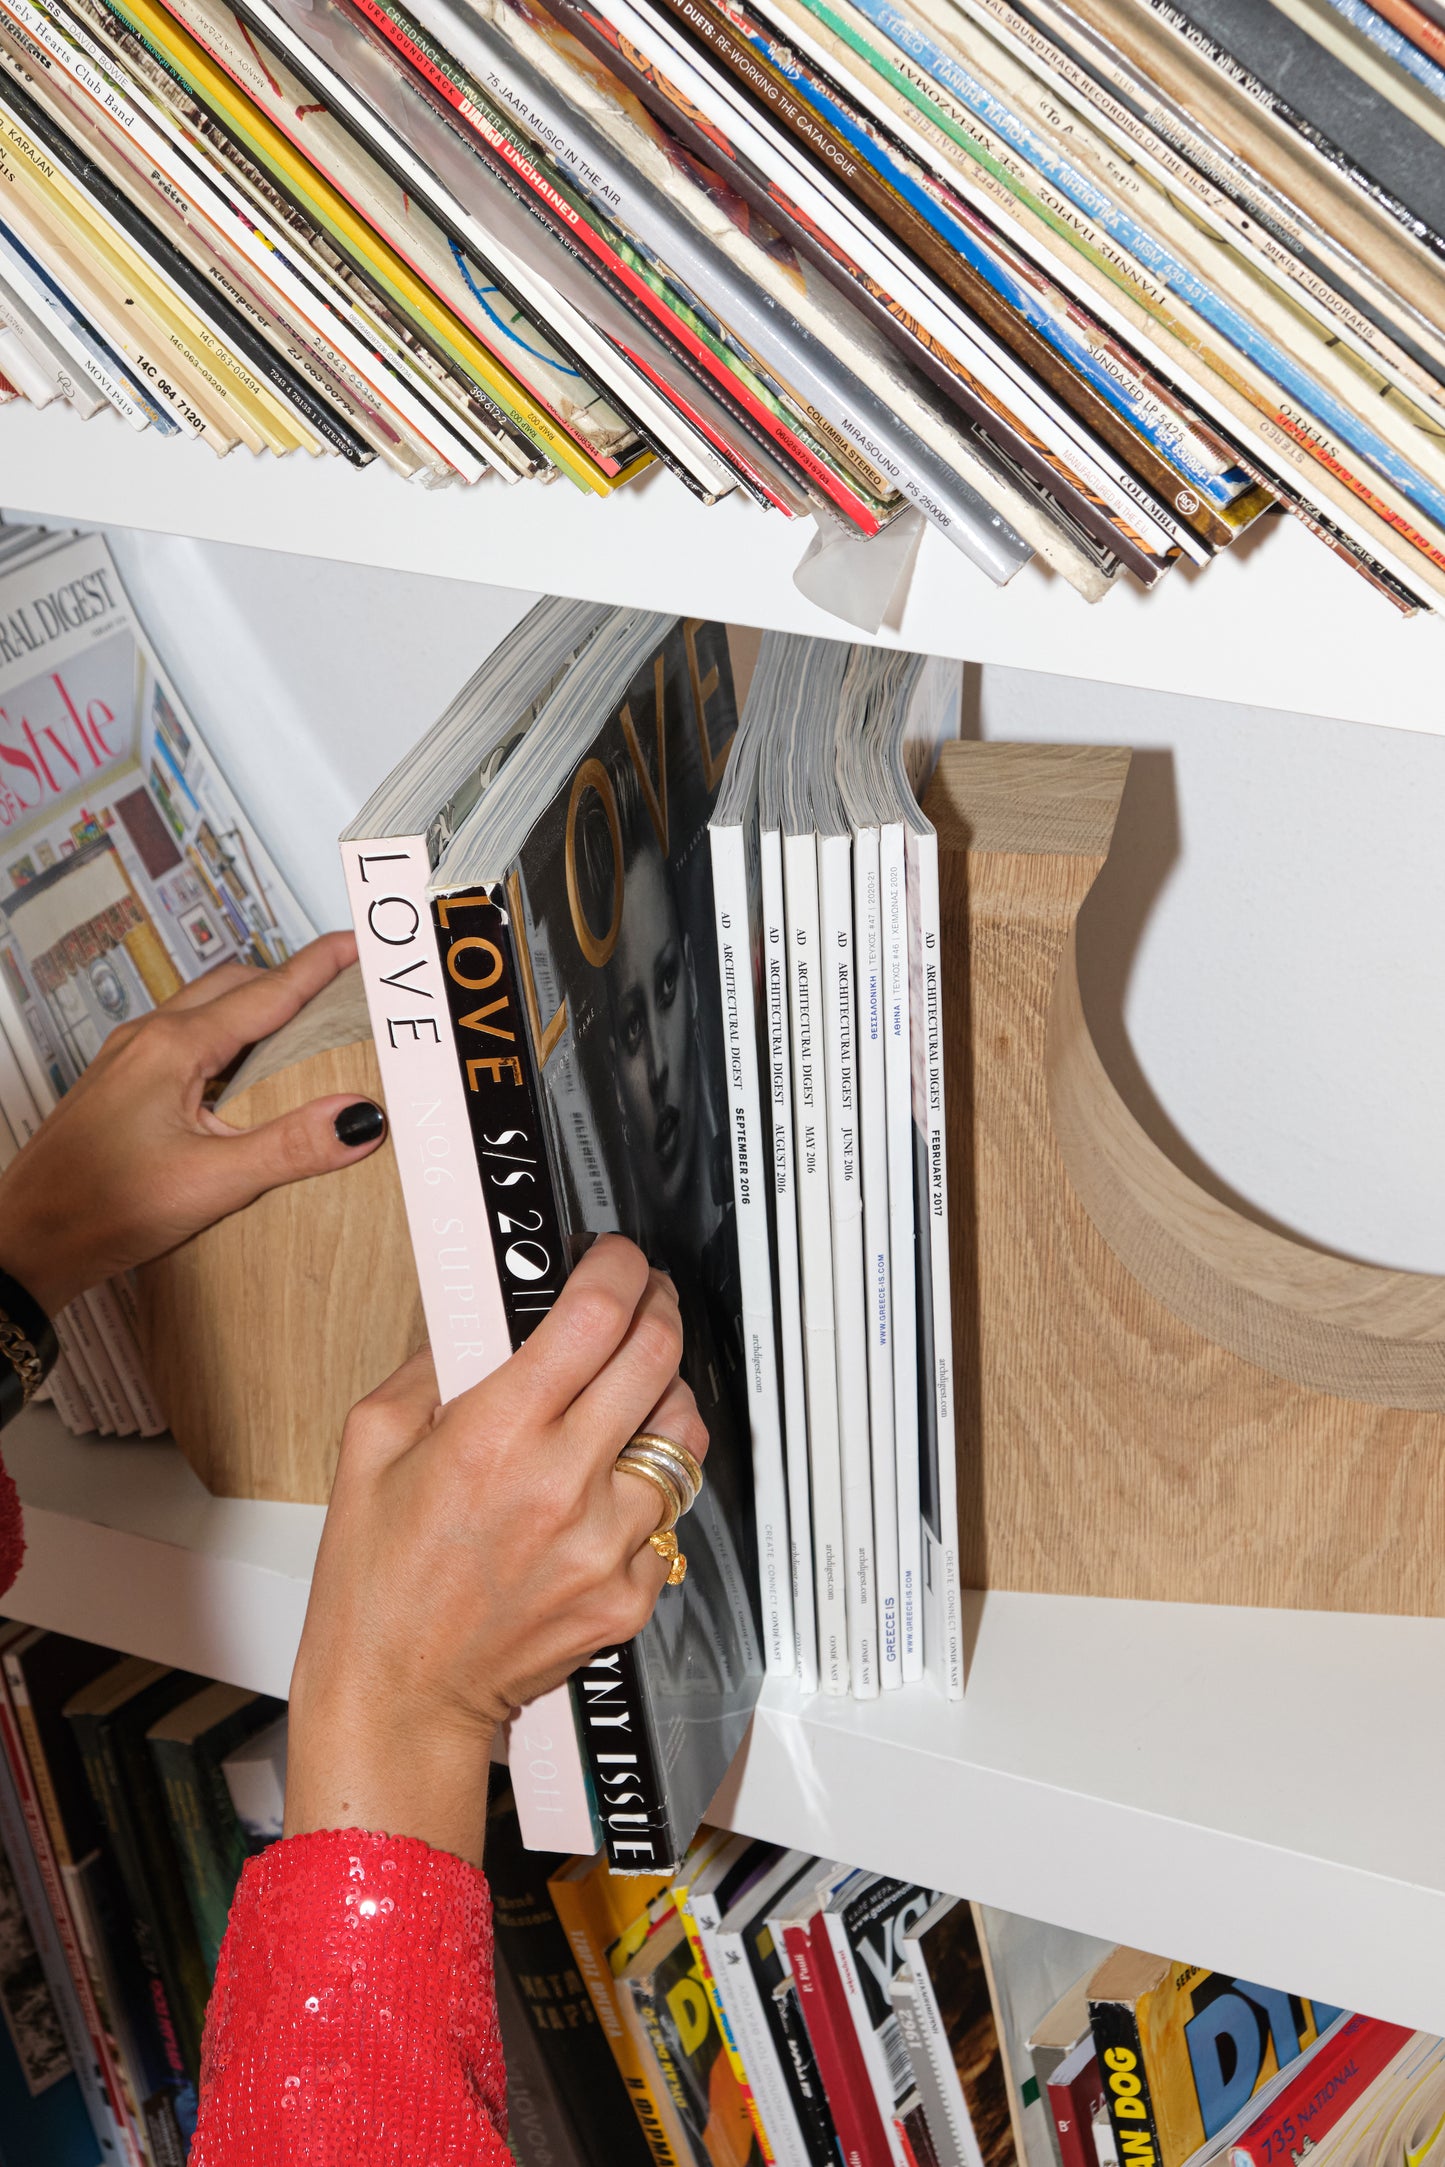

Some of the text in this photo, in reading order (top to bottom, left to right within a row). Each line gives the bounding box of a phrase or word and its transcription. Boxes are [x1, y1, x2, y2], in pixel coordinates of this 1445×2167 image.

[35, 22, 136, 128] Hearts Club Band
[98, 56, 130, 88] BOWIE
[386, 7, 540, 169] CREEDENCE CLEARWATER REVIVAL
[390, 27, 456, 97] SOUNDTRACK
[683, 5, 717, 40] DUETS:
[714, 34, 779, 101] RE-WORKING
[778, 95, 799, 119] THE
[796, 114, 858, 179] CATALOGUE
[1005, 15, 1080, 83] SOUNDTRACK
[1080, 77, 1145, 140] RECORDING
[1144, 136, 1160, 152] OF
[1161, 151, 1184, 172] THE
[8, 129, 54, 178] KARAJAN
[457, 97, 579, 225] DJANGO UNCHAINED
[486, 72, 622, 206] 75 JAAR MUSIC IN THE AIR
[1132, 236, 1206, 303] MSM 430-431
[1265, 241, 1297, 272] MIKIS
[209, 266, 272, 329] Klemperer
[85, 360, 134, 417] MOVLP419
[135, 354, 207, 433] 14C 064 71201
[169, 335, 228, 398] 14C 063-03208
[199, 331, 260, 396] 14C 063-00494
[303, 362, 355, 417] 063-00794
[1086, 343, 1187, 443] SUNDAZED LP 5425
[270, 369, 286, 387] 7243
[292, 391, 312, 414] 78135
[321, 422, 354, 458] STEREO
[470, 385, 507, 425] 399 612-2
[509, 409, 538, 440] RMLP 003
[526, 412, 556, 442] RMLP 002
[1279, 404, 1341, 459] STEREO
[805, 405, 883, 486] COLUMBIA STEREO
[841, 418, 951, 528] MIRASOUND PS 250006
[1259, 421, 1307, 464] STEREO
[1062, 448, 1139, 525] MANUFACTURED IN THE
[1118, 474, 1179, 537] COLUMBIA
[1236, 459, 1340, 551] PHILIPS 6325 201
[32, 567, 117, 641] DIGEST
[867, 871, 876, 904] 2020-21
[357, 851, 443, 1050] LOVE
[869, 933, 877, 966] ΤΕΥΧΟΣ
[889, 866, 902, 1037] ΑΘΗΝΑ ΤΕΥΧΟΣ #46 ΧΕΙΜΩΝΑΣ 2020
[870, 975, 879, 1040] ΘΕΣΣΑΛΟΝΙΚΗ
[721, 912, 751, 1205] AD ARCHITECTURAL DIGEST SEPTEMBER 2016
[769, 926, 787, 1194] AD ARCHITECTURAL DIGEST AUGUST 2016
[796, 929, 816, 1174] AD ARCHITECTURAL DIGEST MAY 2016
[837, 931, 854, 1181] AD ARCHITECTURAL DIGEST JUNE 2016
[926, 931, 943, 1217] AD ARCHITECTURAL DIGEST FEBRUARY 2017
[436, 895, 556, 1313] LOVE S/S 2011
[877, 1253, 887, 1346] WWW.GREECE-IS.COM
[752, 1333, 763, 1394] archdigest.com
[937, 1357, 949, 1419] archdigest.com
[825, 1543, 834, 1601] archdigest.com
[858, 1547, 868, 1605] archdigest.com
[884, 1596, 896, 1663] GREECE IS
[905, 1569, 913, 1655] WWW.GREECE-IS.COM
[774, 1640, 782, 1662] NAST
[951, 1666, 959, 1688] NAST
[523, 1734, 566, 1814] 2011
[595, 1754, 656, 1861] ISSUE
[898, 2008, 923, 2050] 1962
[1103, 2046, 1148, 2120] DOG
[1261, 2058, 1361, 2165] 735 NATIONAL
